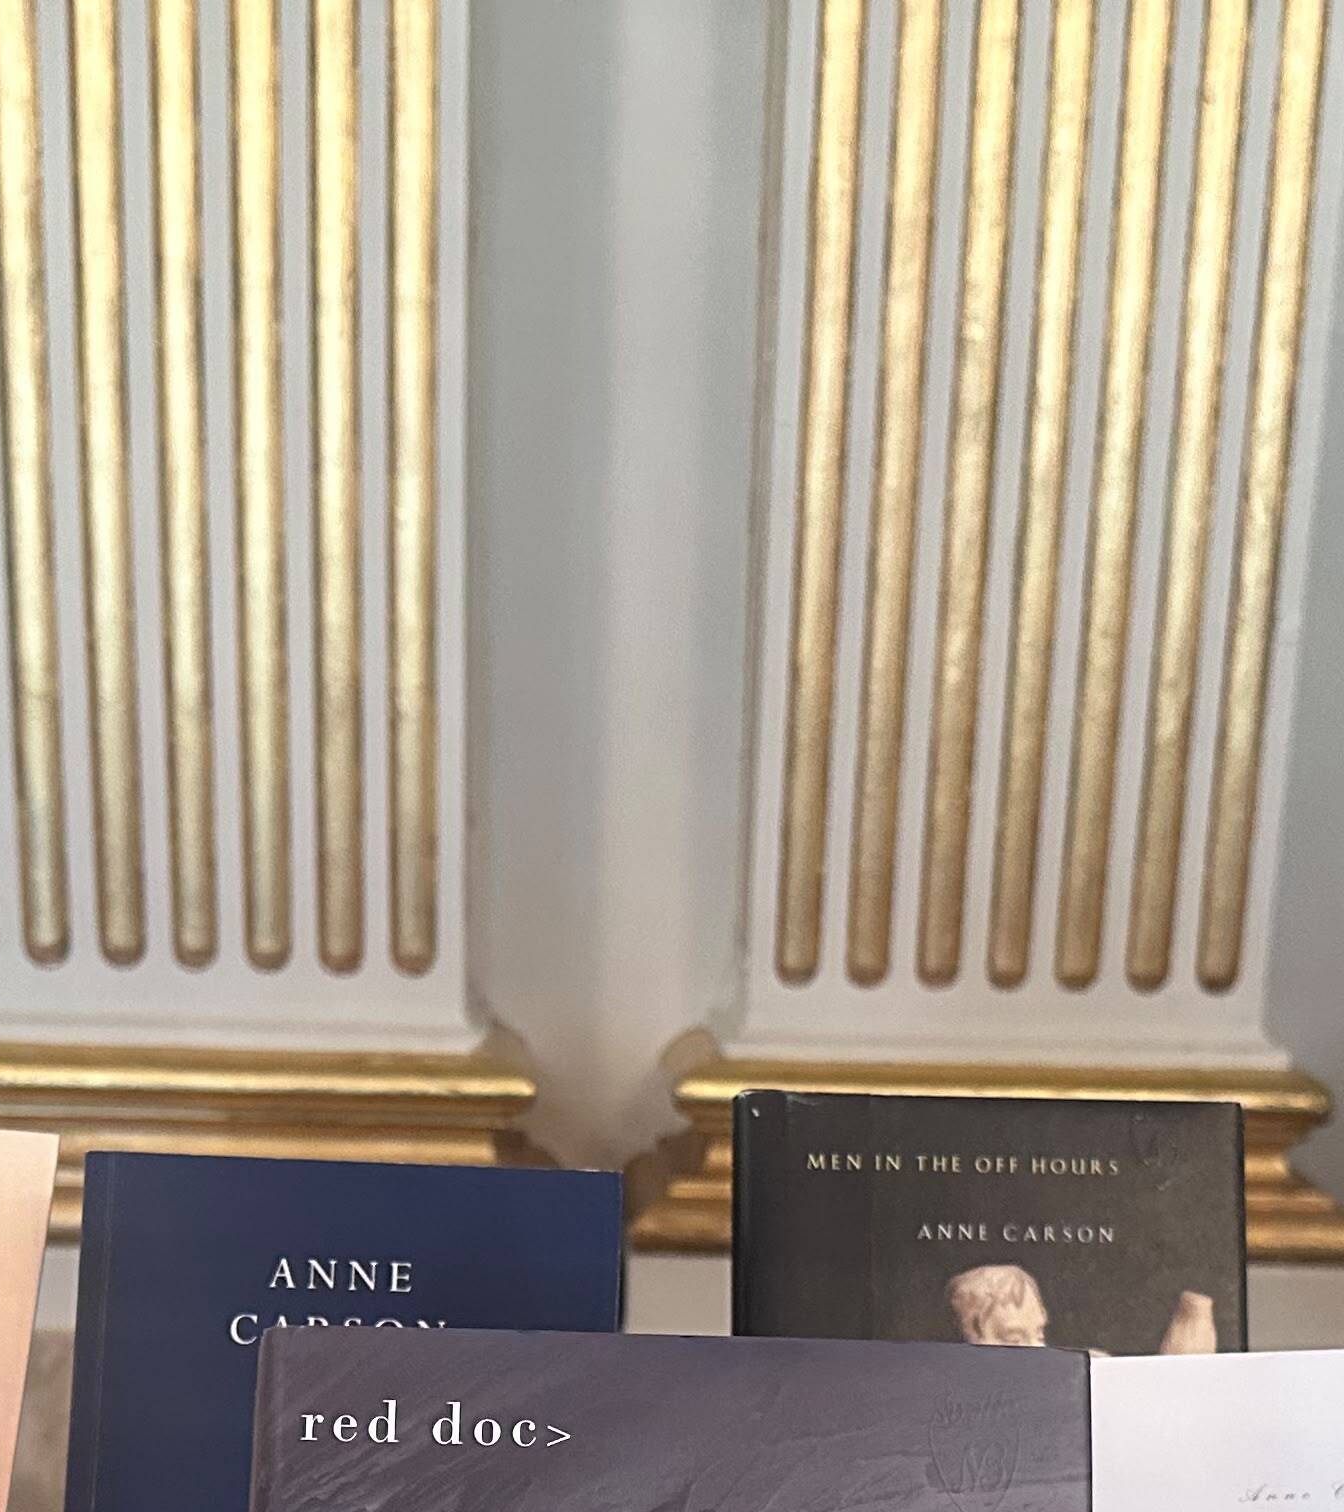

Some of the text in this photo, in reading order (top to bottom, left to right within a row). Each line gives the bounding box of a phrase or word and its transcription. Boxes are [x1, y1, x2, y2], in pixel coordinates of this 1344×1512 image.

[806, 1153, 1120, 1176] MEN IN THE OFF HOURS
[917, 1223, 1115, 1244] ANNE CARSON
[269, 1257, 412, 1293] ANNE
[300, 1399, 572, 1448] red doc>
